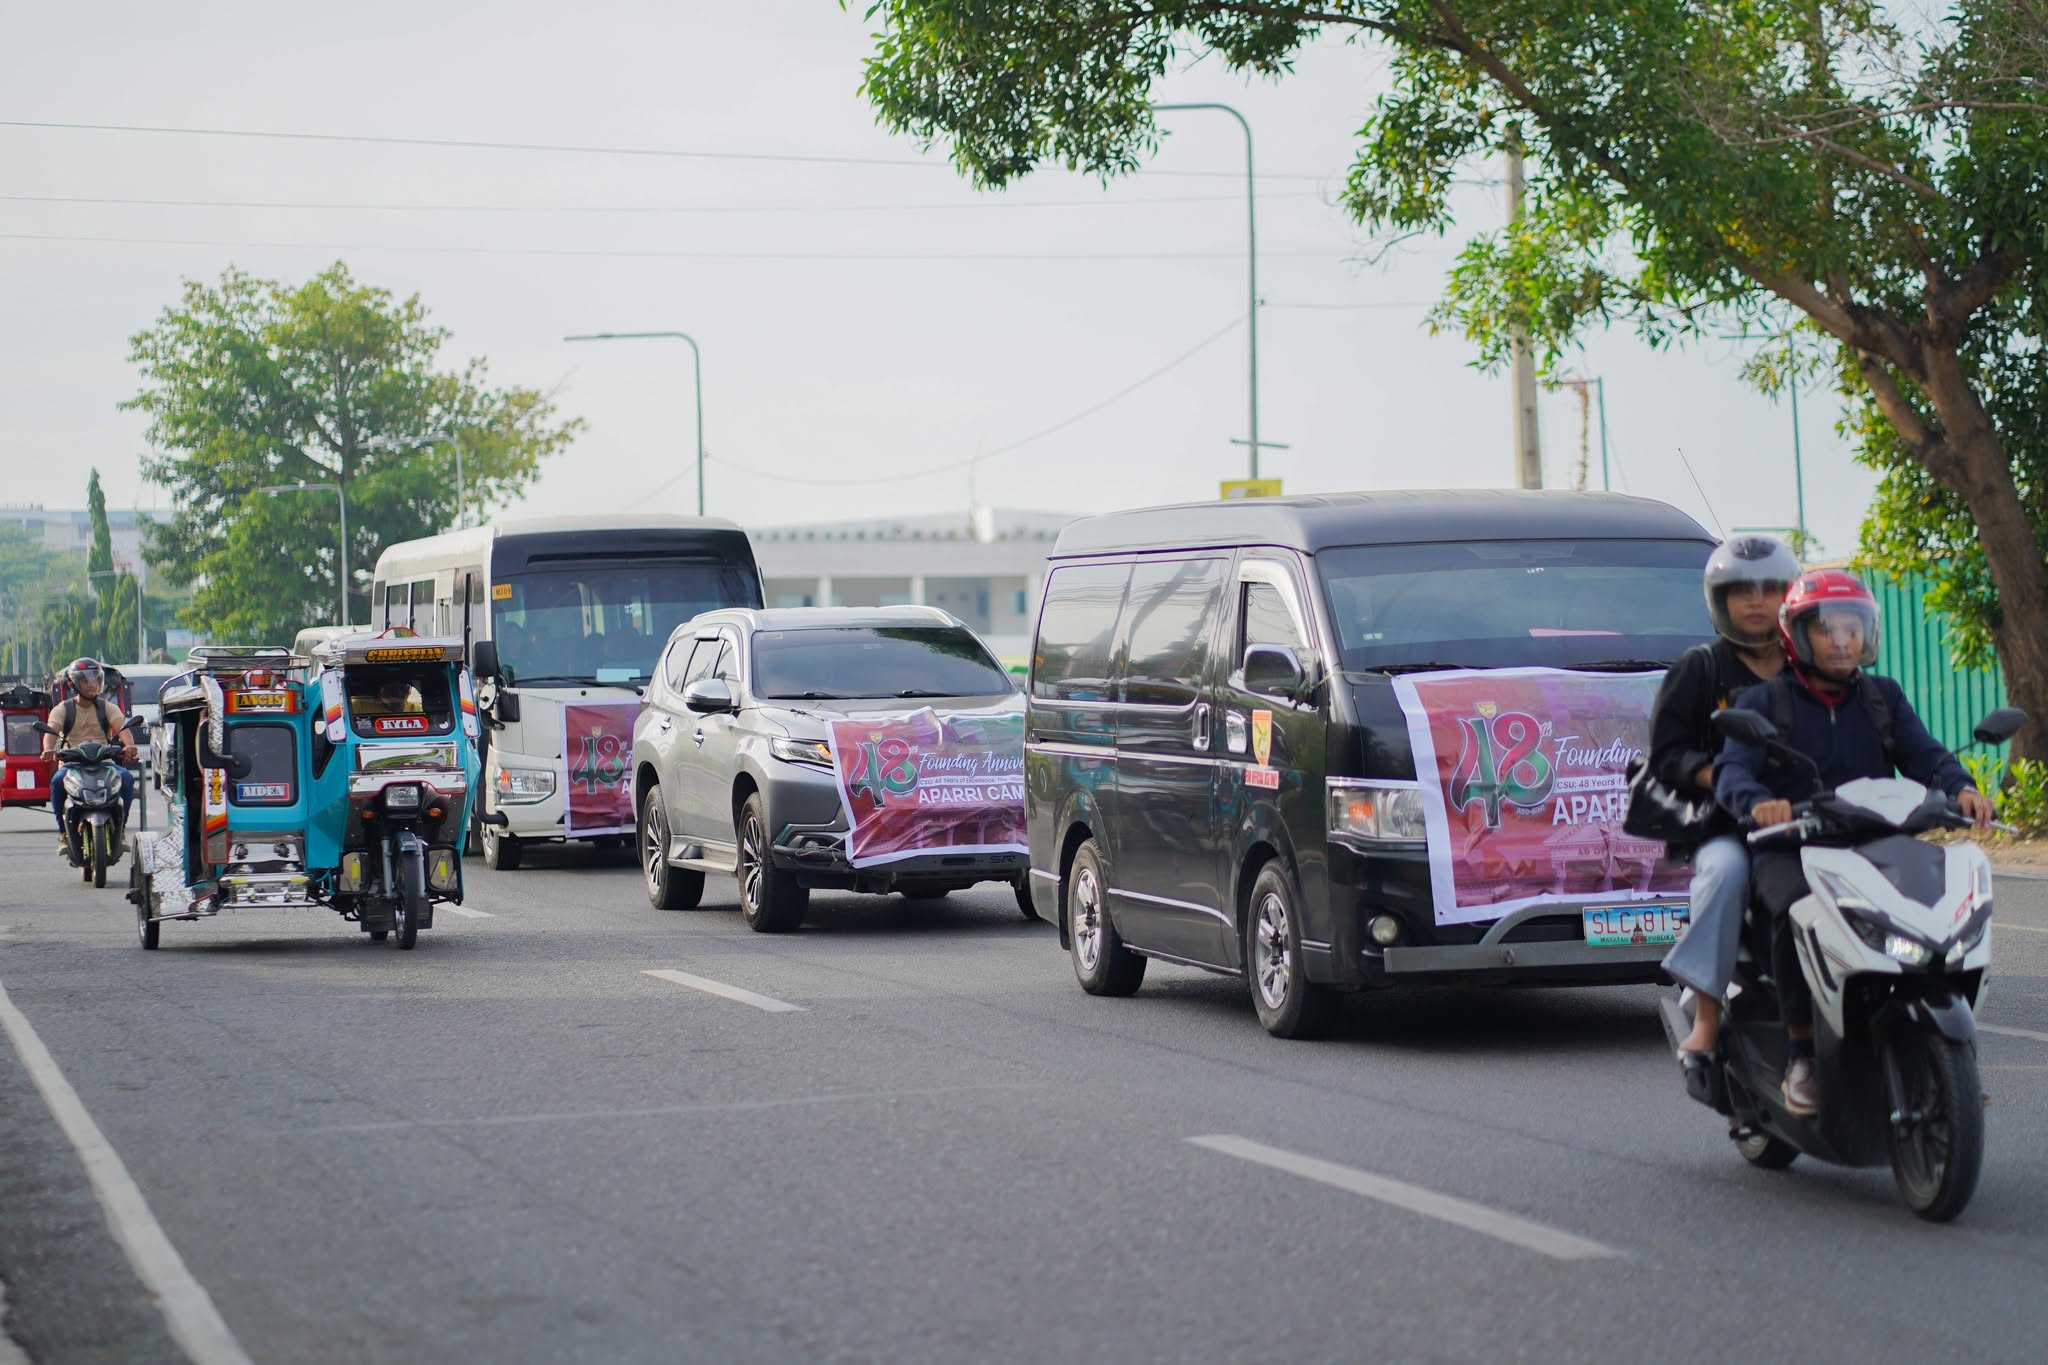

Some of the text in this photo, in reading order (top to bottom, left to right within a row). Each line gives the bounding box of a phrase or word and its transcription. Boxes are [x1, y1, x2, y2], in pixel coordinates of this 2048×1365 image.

[366, 647, 445, 662] CHRISTIAN
[381, 719, 424, 730] KYLA
[919, 752, 978, 778] Founding
[1556, 781, 1577, 789] CSU:
[1579, 779, 1590, 788] 48
[1591, 778, 1616, 787] Years
[242, 786, 285, 797] AIDEN
[919, 787, 984, 804] APARRI
[1592, 909, 1684, 935] SLC 815
